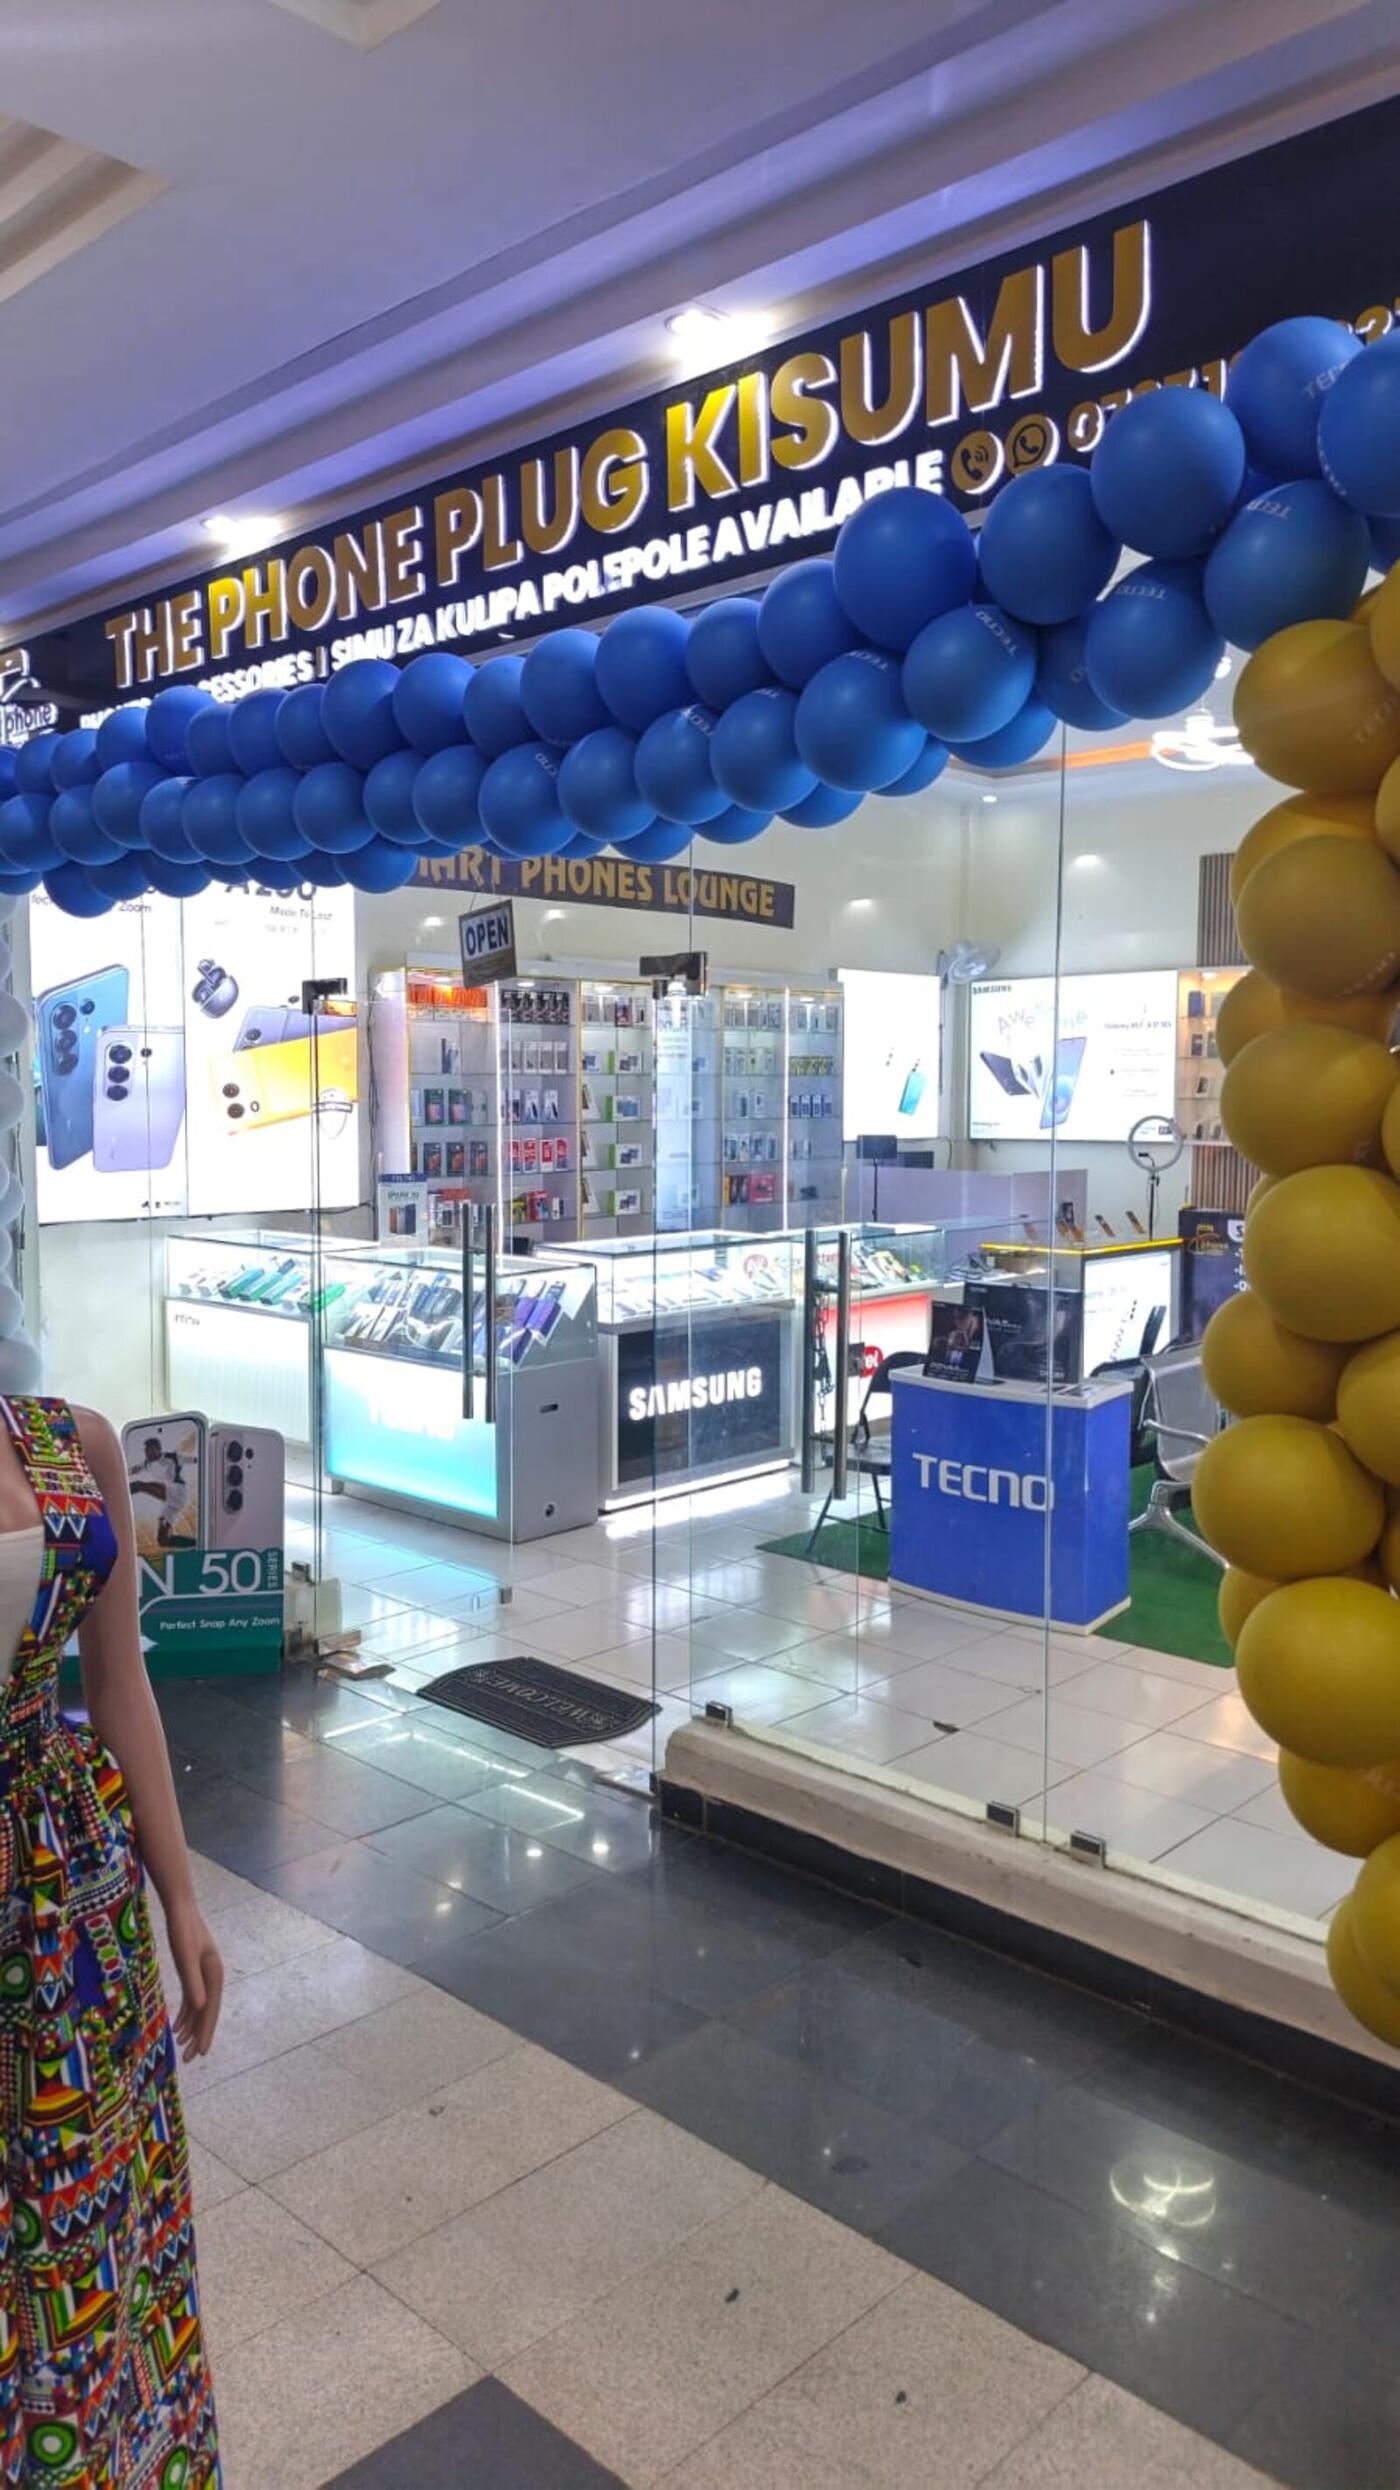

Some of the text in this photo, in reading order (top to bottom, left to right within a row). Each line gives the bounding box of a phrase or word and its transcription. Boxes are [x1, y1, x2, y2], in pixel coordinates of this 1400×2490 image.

[105, 590, 204, 688] THE
[207, 504, 426, 660] PHONE
[434, 428, 650, 588] PLUG
[665, 218, 1153, 514] KISUMU
[331, 624, 396, 671] SIMU
[396, 612, 435, 653] ZA
[435, 580, 541, 641] KULIPA
[521, 856, 655, 903] PHONES
[663, 868, 775, 919] LOUNGE
[465, 914, 510, 957] OPEN
[628, 1366, 763, 1422] SAMSUNG
[911, 1451, 1055, 1513] TECNO
[198, 1550, 262, 1595] 50
[266, 1551, 279, 1589] SERIES
[160, 1616, 281, 1631] Perfect Snap Any Zoom
[488, 1677, 591, 1724] WELCOME
